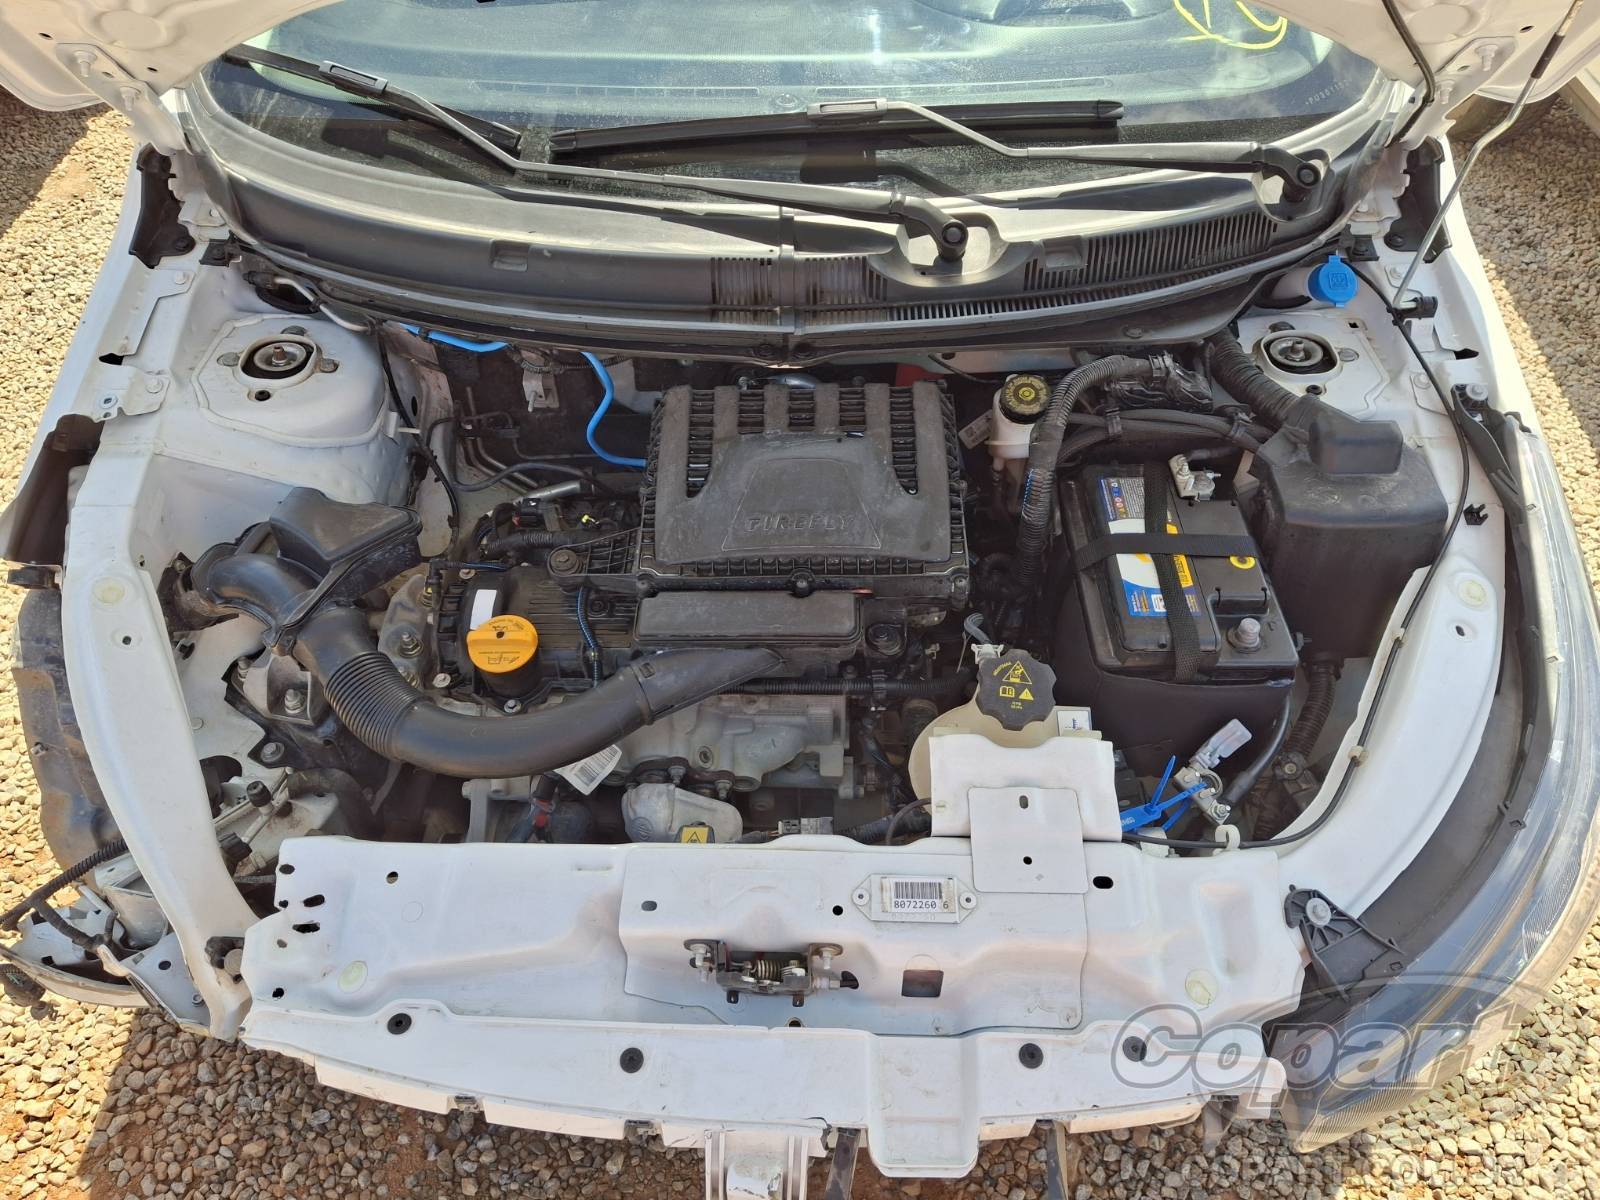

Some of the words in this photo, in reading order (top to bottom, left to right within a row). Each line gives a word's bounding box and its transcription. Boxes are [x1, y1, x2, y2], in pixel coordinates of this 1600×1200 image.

[744, 512, 854, 532] FIREFLY
[894, 900, 937, 909] 8072260
[942, 900, 949, 909] 6
